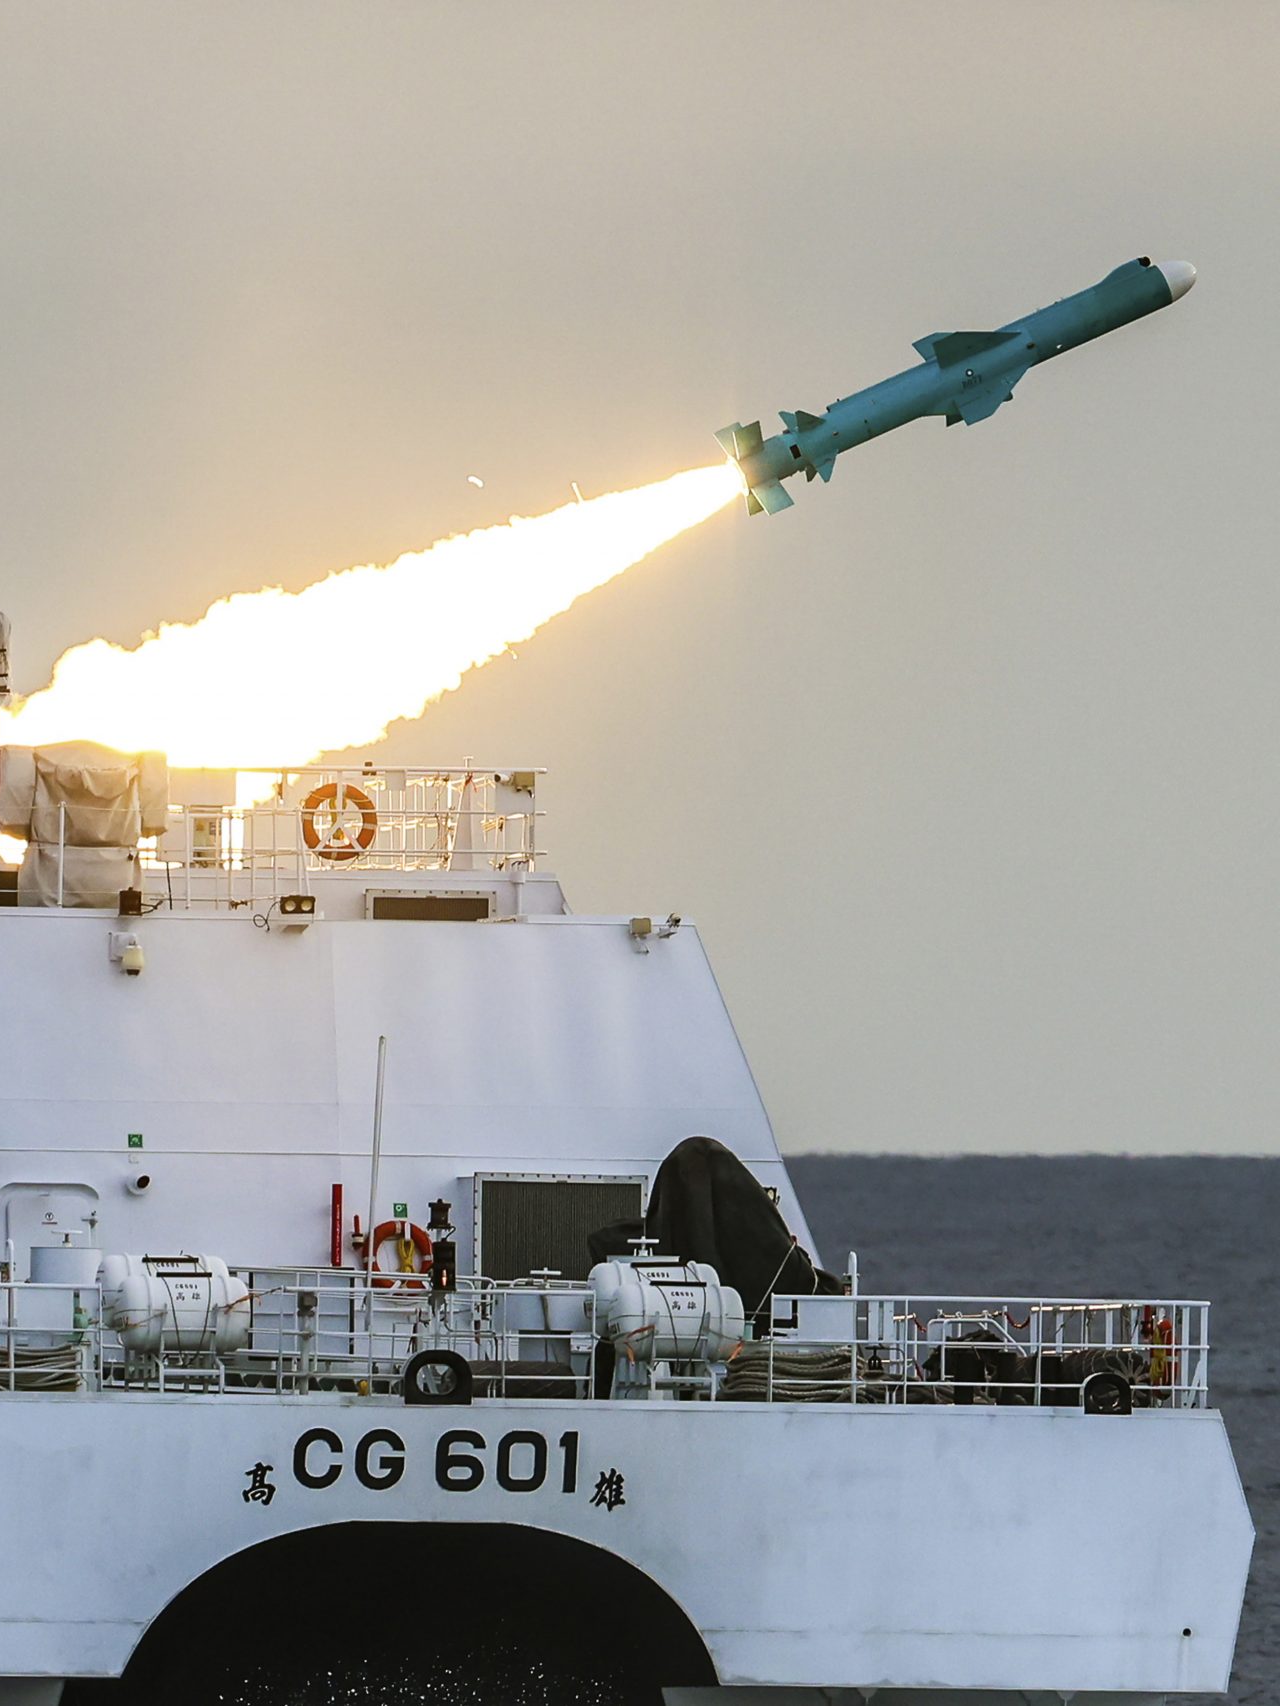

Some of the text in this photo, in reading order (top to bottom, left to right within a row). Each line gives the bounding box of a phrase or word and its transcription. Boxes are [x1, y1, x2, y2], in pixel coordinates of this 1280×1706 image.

[294, 1428, 578, 1493] CG 601
[590, 1468, 625, 1512] 雄
